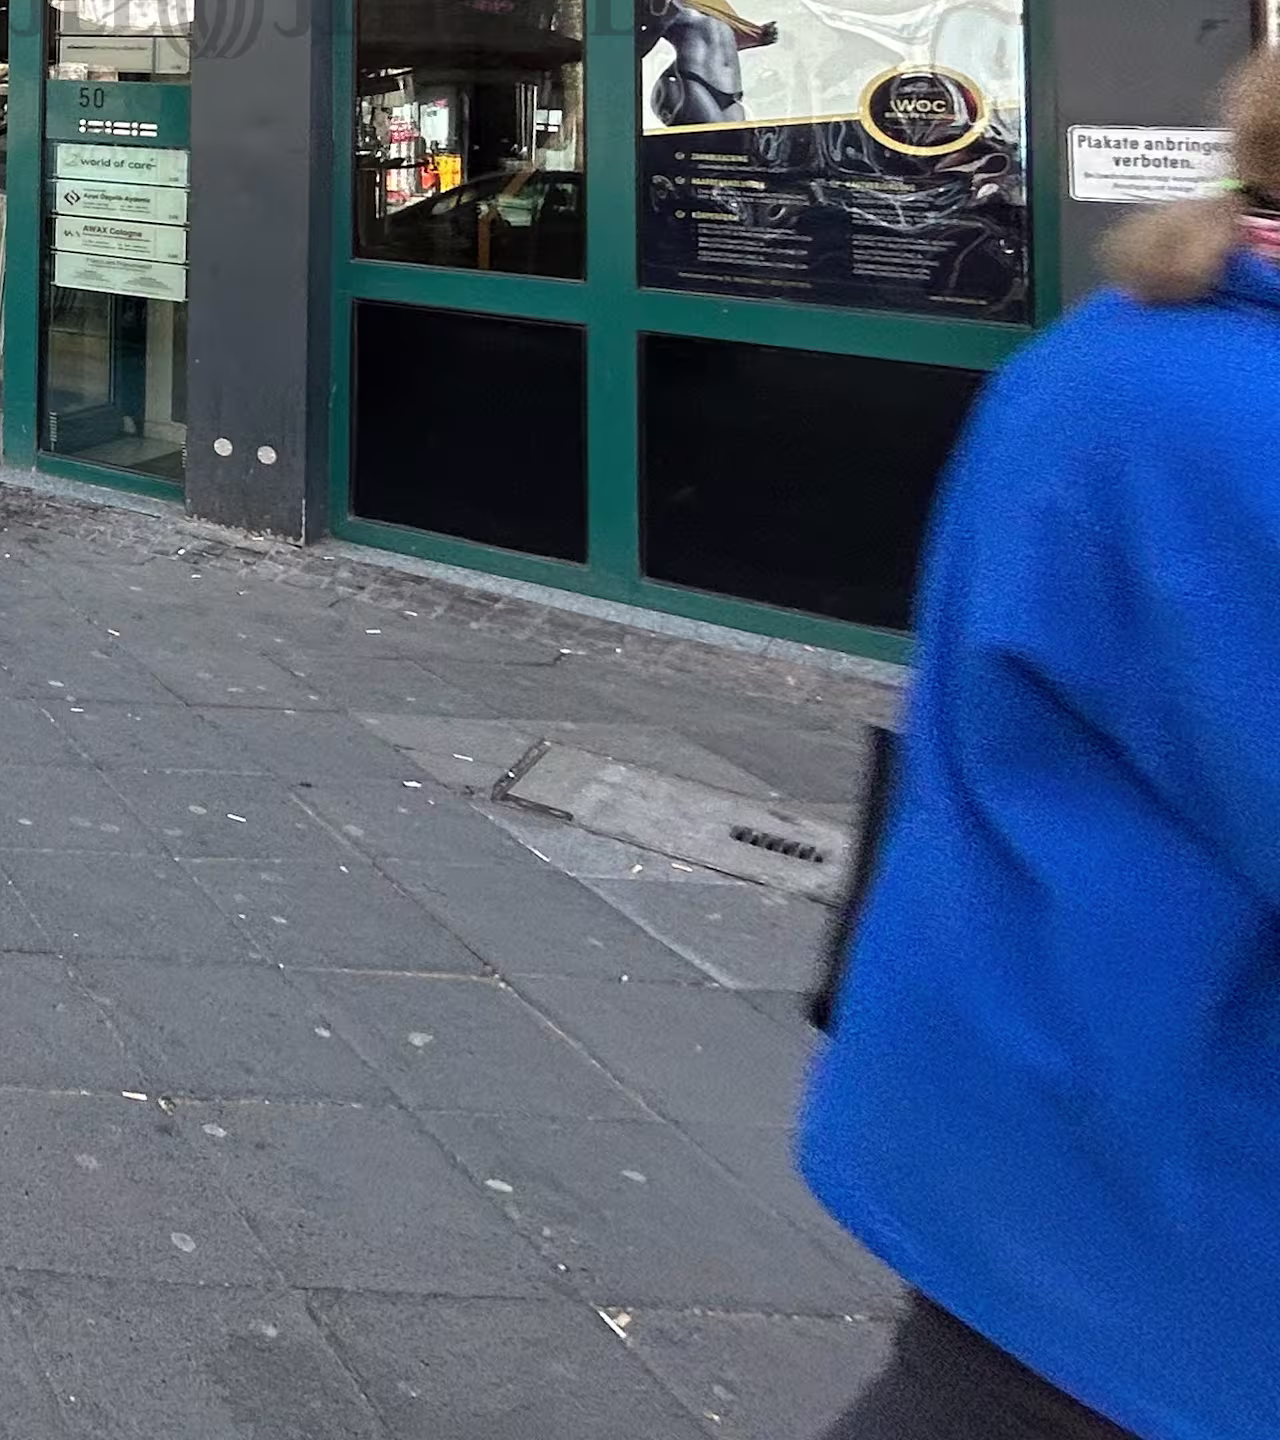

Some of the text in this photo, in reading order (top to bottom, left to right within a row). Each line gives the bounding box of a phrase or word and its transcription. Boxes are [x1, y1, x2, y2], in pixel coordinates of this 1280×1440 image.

[79, 87, 105, 109] 50
[1077, 135, 1140, 150] Plakate
[80, 158, 111, 168] world
[113, 159, 125, 168] of
[109, 228, 143, 239] Cologne
